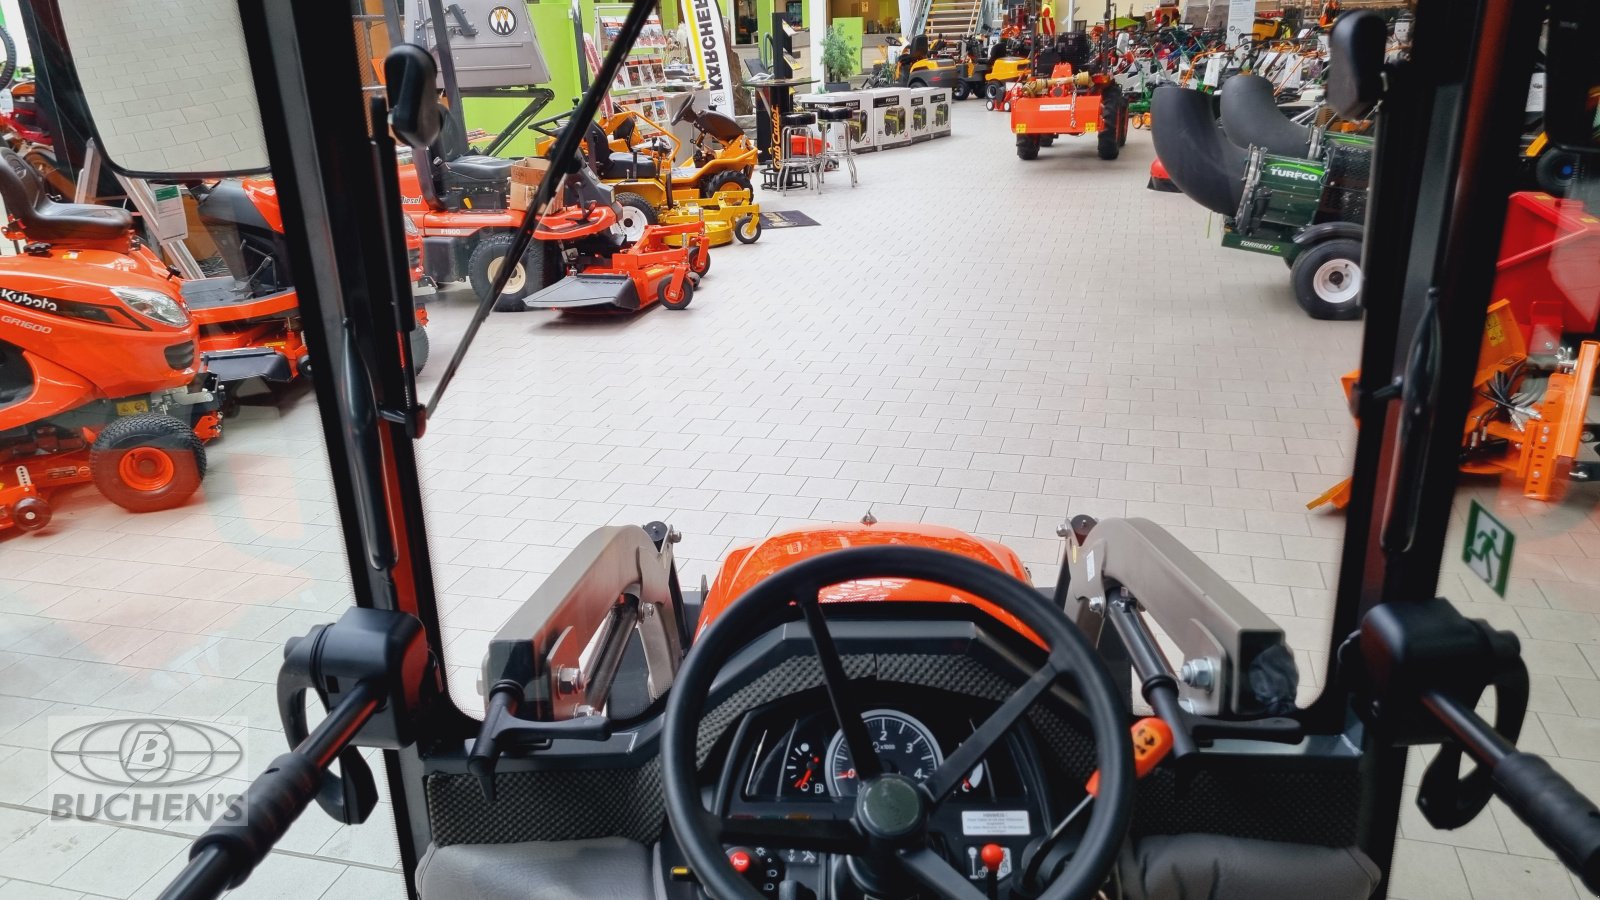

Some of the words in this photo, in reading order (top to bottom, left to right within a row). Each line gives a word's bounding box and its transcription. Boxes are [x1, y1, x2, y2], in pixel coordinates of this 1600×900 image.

[1270, 166, 1318, 181] TURFCO
[1240, 240, 1273, 250] TORRENT
[1, 289, 57, 311] Kubota
[1, 315, 52, 334] GR1600
[880, 731, 888, 741] 2
[905, 743, 914, 754] 3
[914, 768, 923, 779] 4
